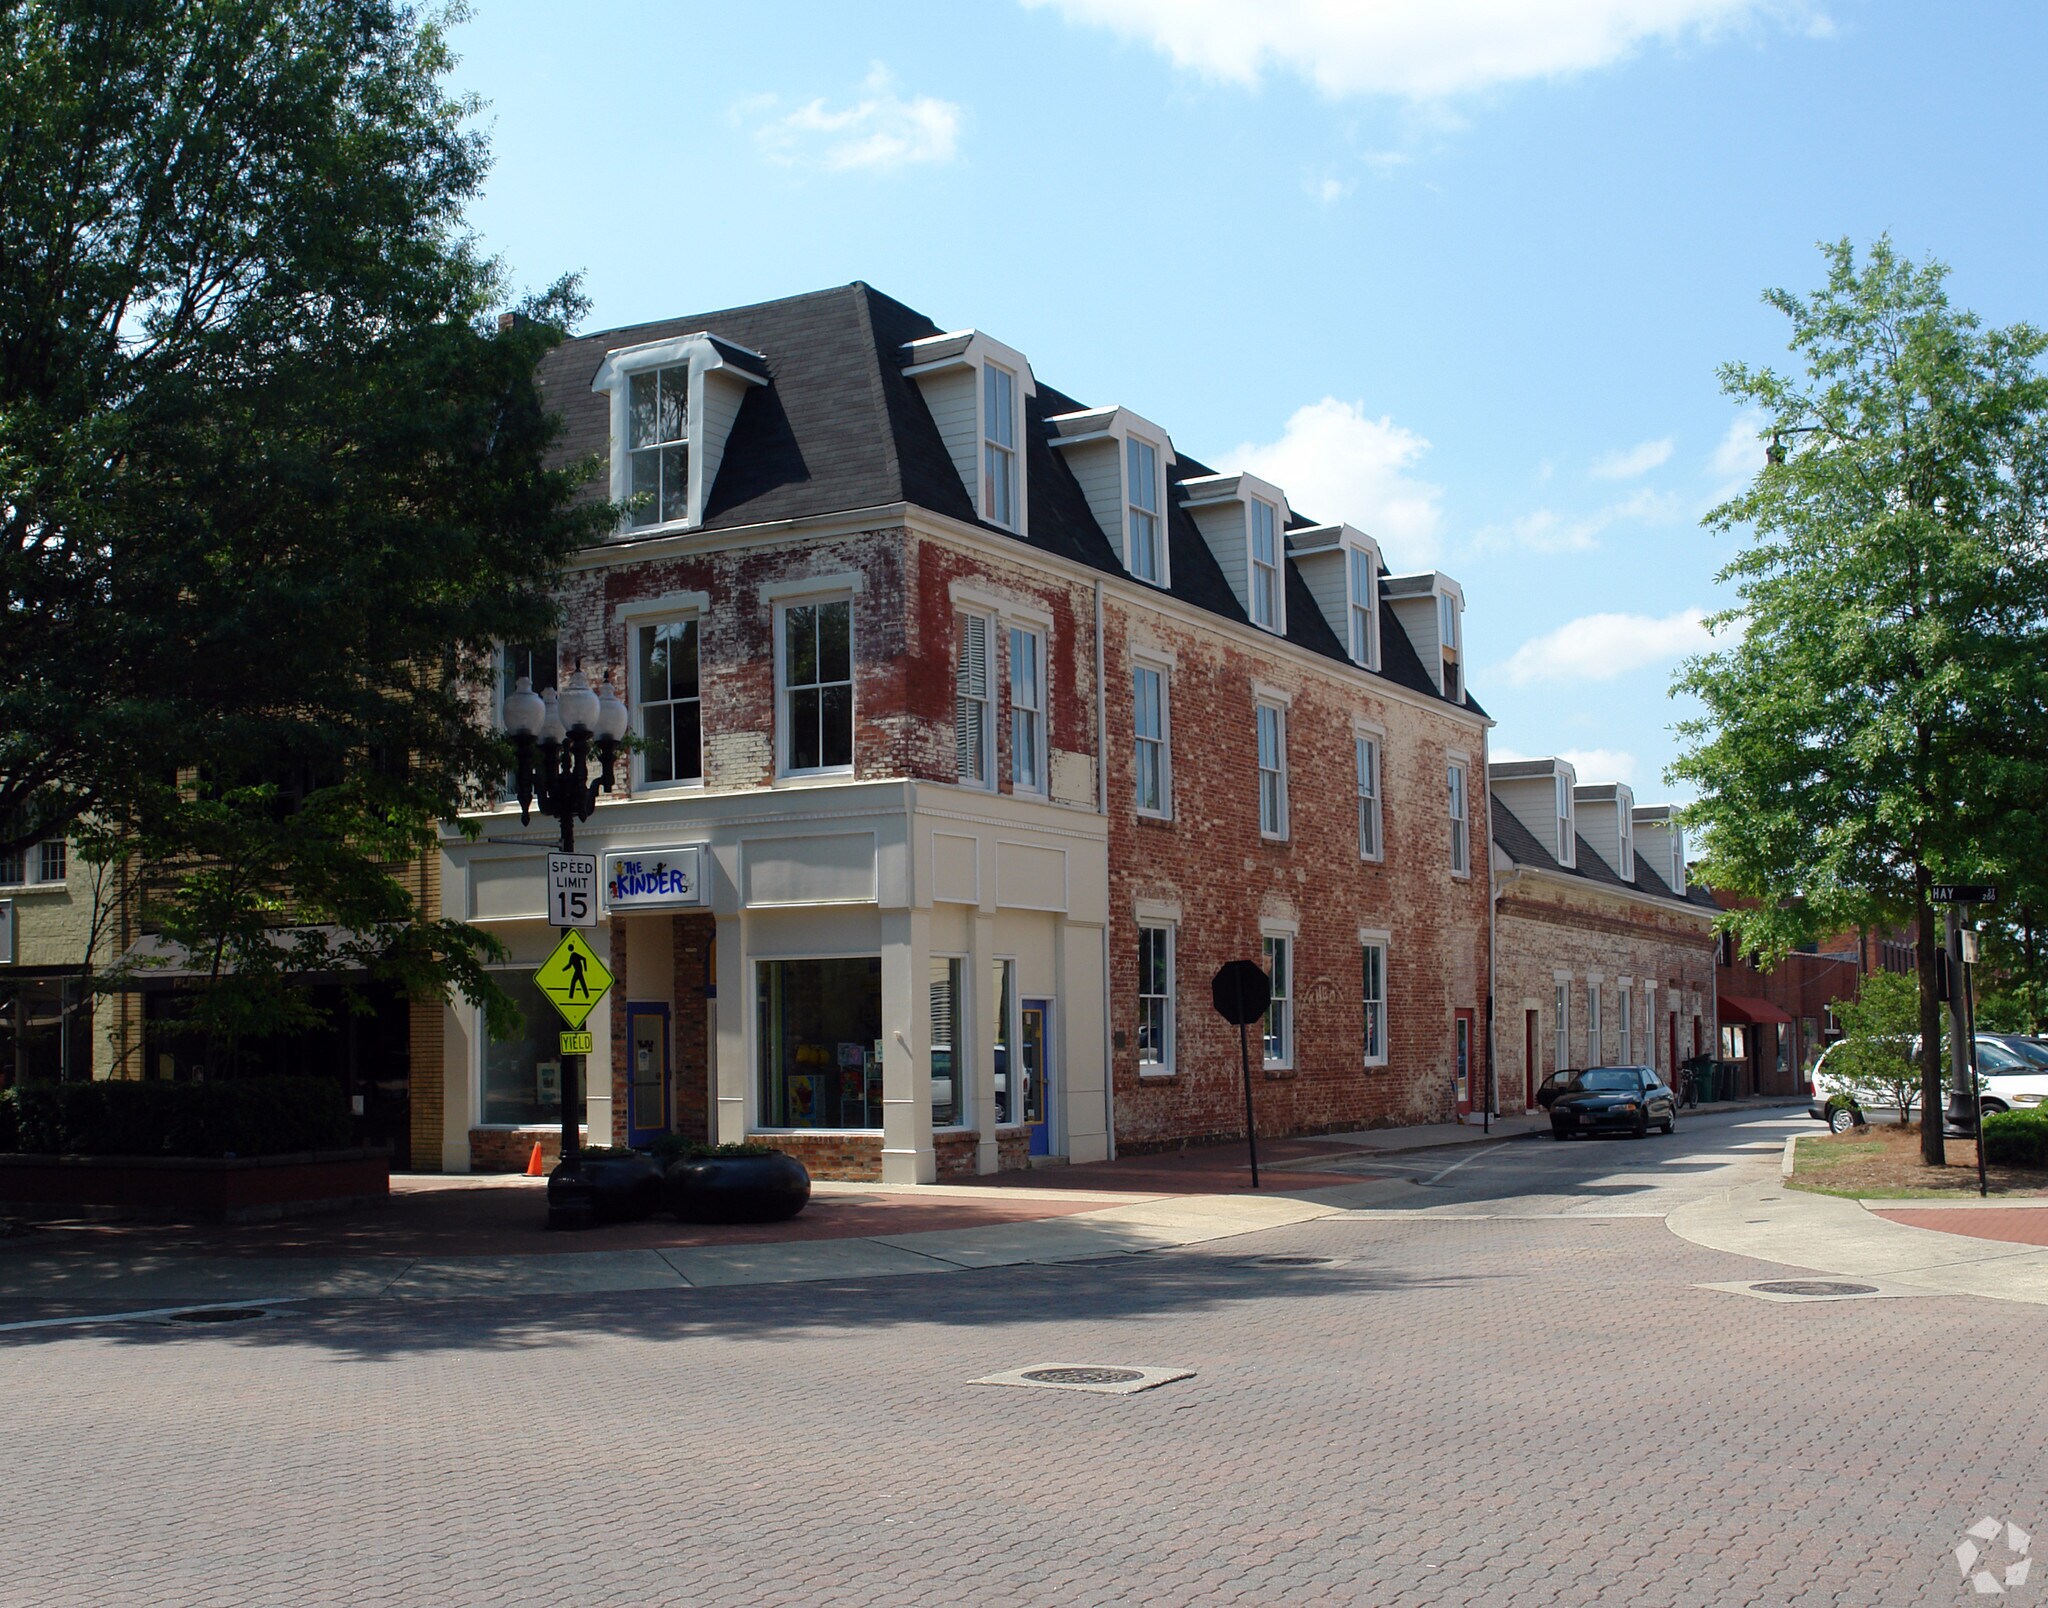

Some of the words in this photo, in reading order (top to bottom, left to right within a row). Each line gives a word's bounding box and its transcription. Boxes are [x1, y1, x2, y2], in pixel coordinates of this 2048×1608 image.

[552, 861, 593, 874] SPEED
[624, 861, 643, 875] THE
[557, 878, 588, 889] LIMIT
[616, 869, 684, 899] KINDER
[1932, 887, 1954, 900] HAY
[558, 892, 588, 919] 15
[563, 1036, 590, 1050] YIELD
